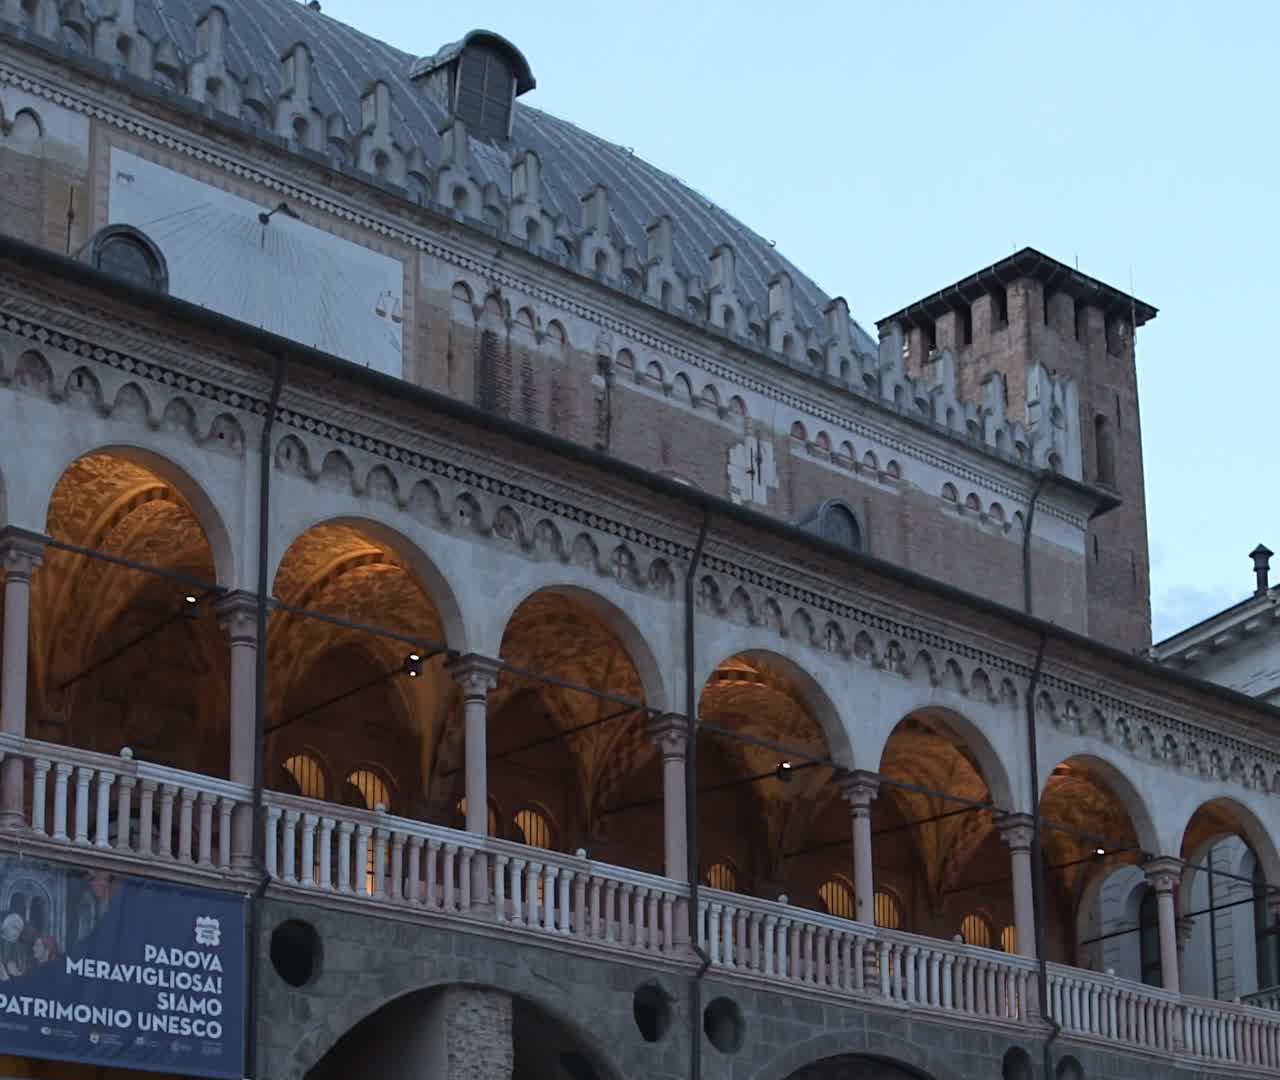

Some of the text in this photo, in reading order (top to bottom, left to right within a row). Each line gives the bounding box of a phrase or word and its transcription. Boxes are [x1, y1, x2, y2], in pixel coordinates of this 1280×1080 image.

[144, 944, 223, 972] PADOVA
[66, 956, 223, 995] MERAVIGLIOSA!
[157, 991, 223, 1017] SIAMO
[138, 1012, 223, 1039] UNESCO
